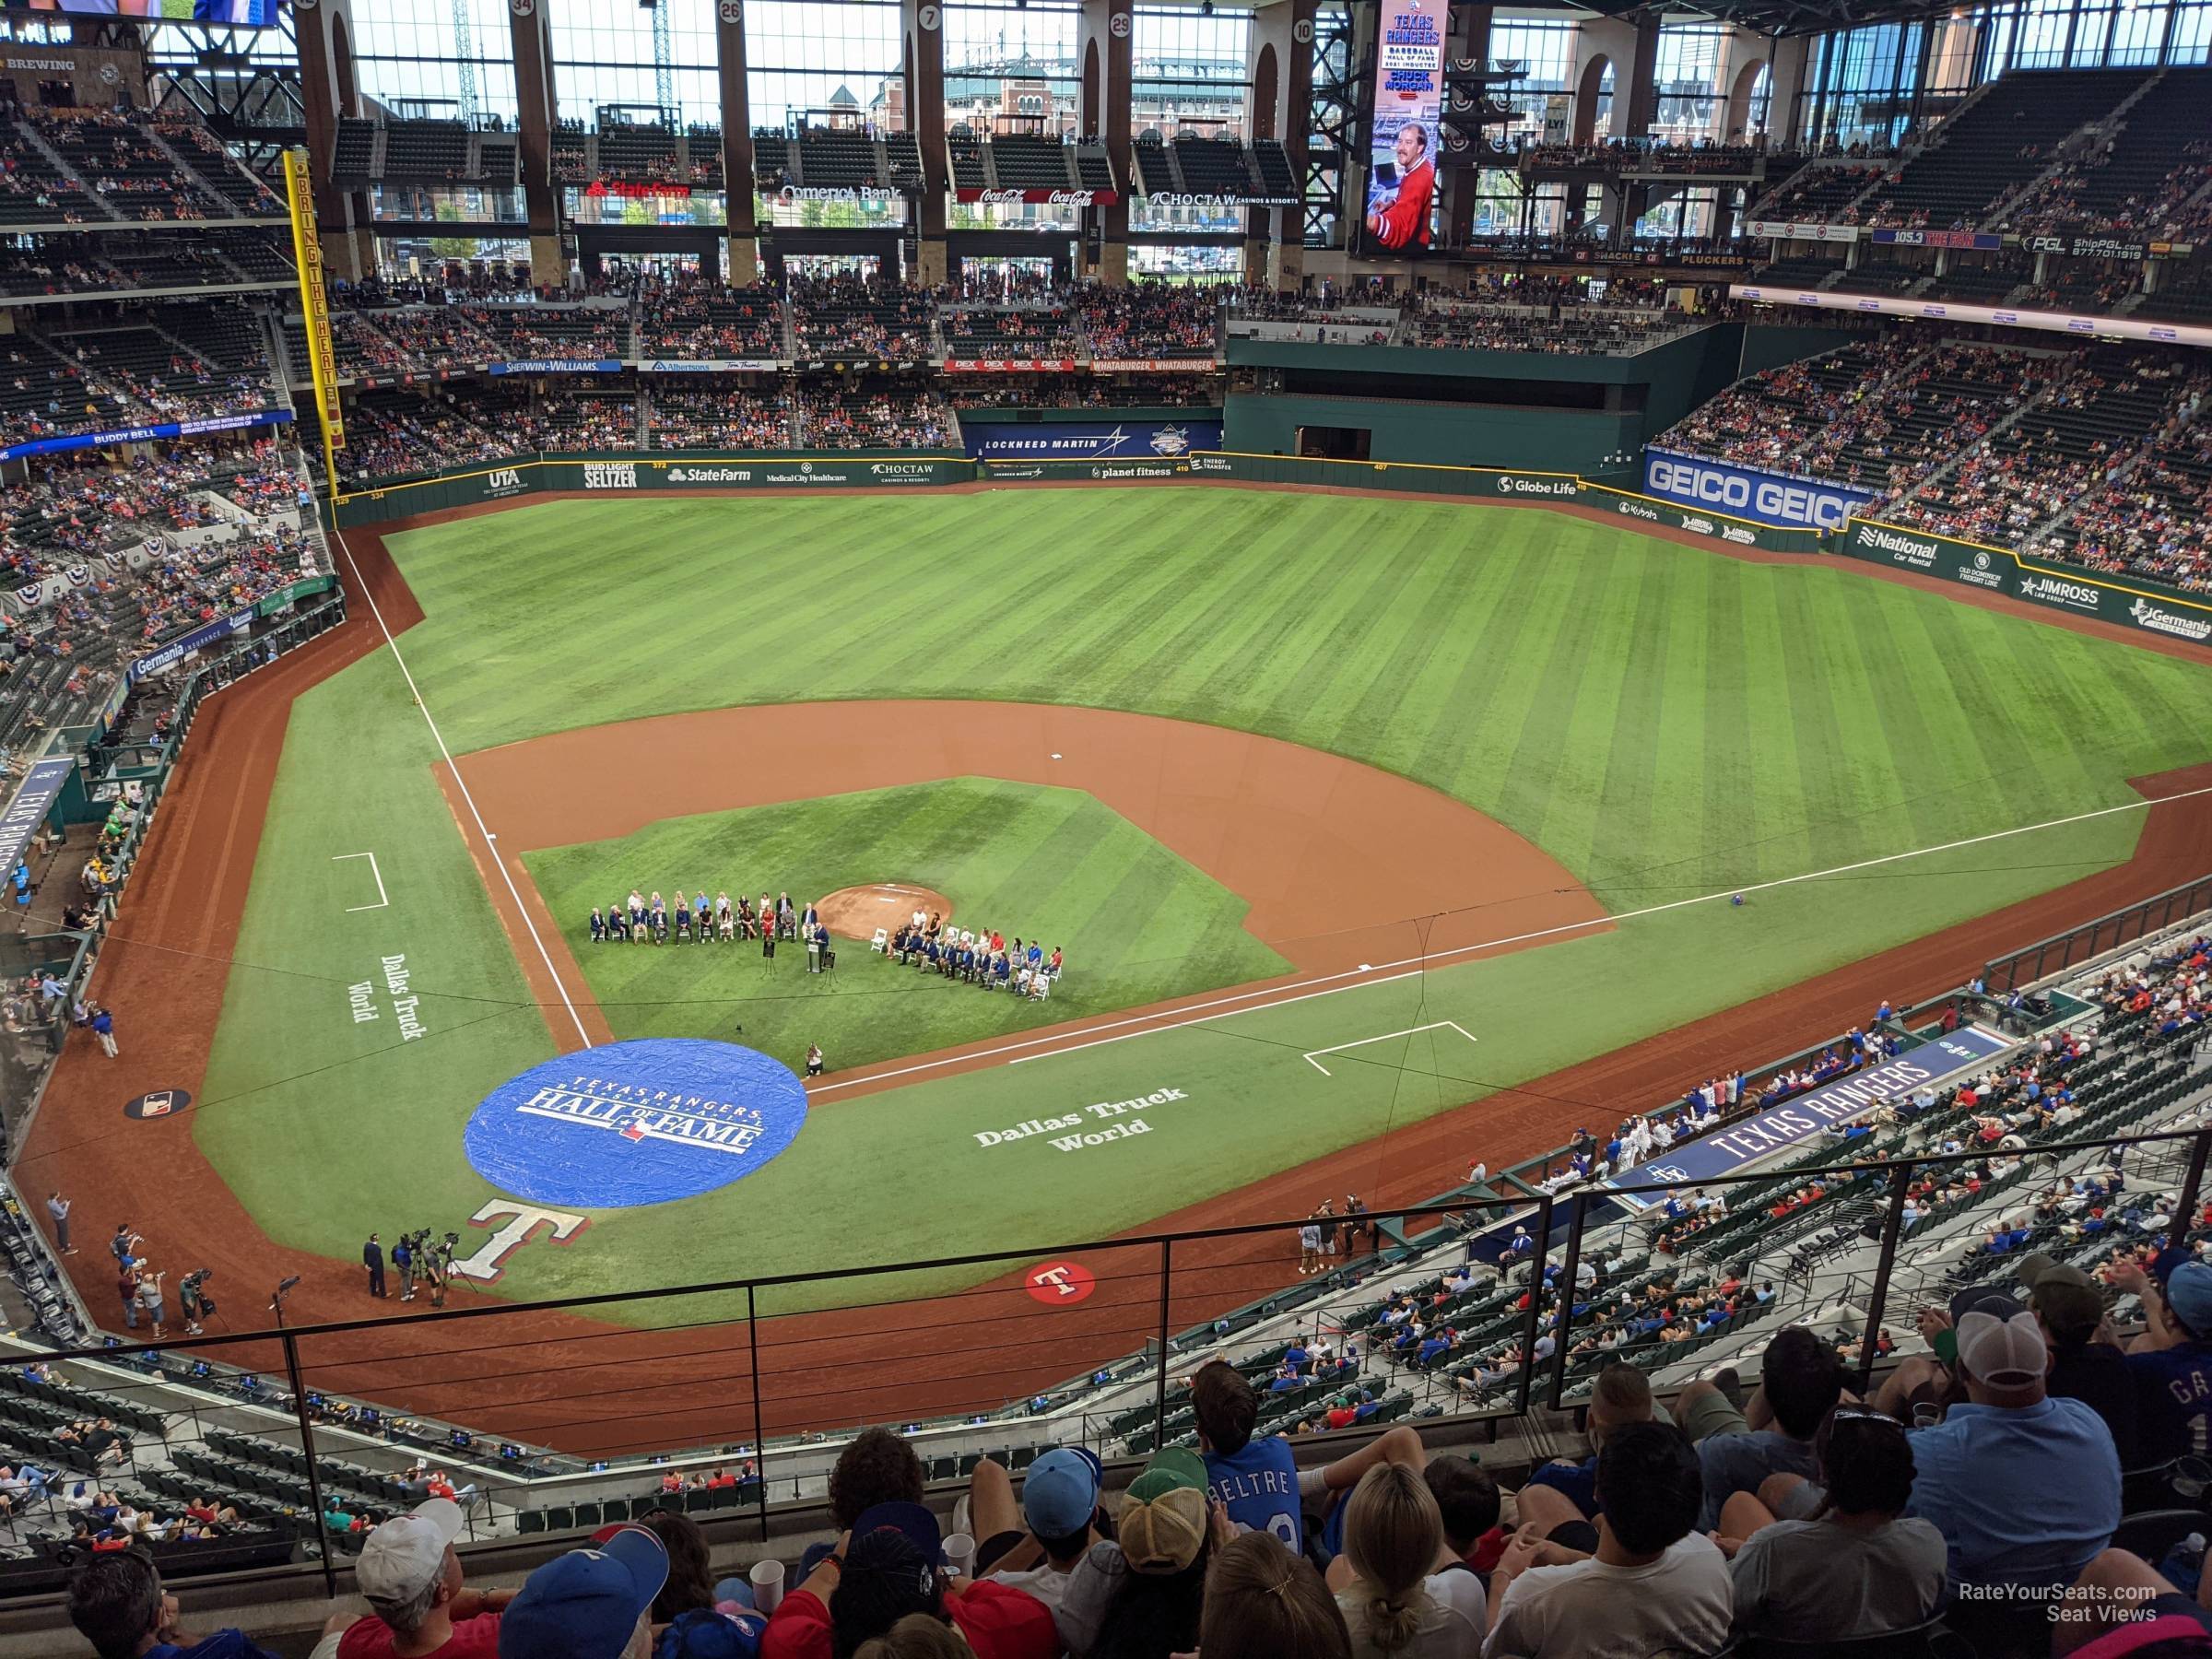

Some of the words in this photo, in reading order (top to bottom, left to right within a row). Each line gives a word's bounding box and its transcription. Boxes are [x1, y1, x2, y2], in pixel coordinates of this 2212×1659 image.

[722, 3, 739, 18] 26
[925, 11, 935, 25] 7
[1112, 18, 1129, 32] 29
[1394, 14, 1434, 29] TEXAS
[1297, 25, 1310, 39] 10
[1385, 29, 1440, 45] RANGERS
[1389, 47, 1435, 55] BASEBALL
[6, 58, 76, 71] BREWING
[1390, 71, 1430, 81] CHUCK
[1385, 81, 1434, 92] MORGAN
[860, 185, 901, 201] Bank
[1159, 192, 1236, 207] CHOCTAW
[1894, 231, 1924, 243] 105.3
[1925, 232, 1947, 245] THE
[1949, 233, 1975, 248] FAN
[2031, 238, 2066, 251] PGL
[2074, 239, 2143, 252] ShipPGL.com
[1681, 255, 1744, 266] PLUCKERS
[2072, 248, 2141, 260] 877.701.1919
[667, 362, 710, 371] Albertsons
[1093, 360, 1150, 371] WHATABURGER
[1155, 360, 1212, 371] WHATABURGER
[414, 373, 431, 382] TOYOTA
[449, 370, 466, 378] TOYOTA
[94, 432, 129, 444] BUDDY
[131, 429, 157, 440] BELL
[985, 440, 1047, 449] LOCKHEED
[1053, 439, 1098, 448] MARTIN
[688, 468, 721, 481] State
[721, 468, 751, 481] Farm
[878, 464, 934, 474] CHOCTAW
[1102, 467, 1135, 478] planet
[1136, 466, 1171, 477] fitness
[489, 469, 520, 488] UTA
[584, 470, 637, 488] SELTZER
[767, 474, 794, 483] Medical
[794, 474, 808, 484] City
[809, 474, 847, 483] Healthcare
[1649, 460, 1749, 508] GEICO
[1515, 480, 1548, 494] Globe
[1551, 483, 1575, 496] Life
[335, 497, 349, 506] 329
[371, 492, 384, 500] 334
[1630, 506, 1658, 521] Kubota
[1691, 518, 1712, 530] ARROW
[1731, 528, 1752, 540] ARROW
[1894, 553, 1907, 561] Car
[1908, 556, 1932, 568] Rental
[1959, 566, 1977, 576] OLD
[1971, 570, 2002, 582] DOMINION
[1959, 573, 1984, 586] FREIGHT
[1984, 578, 1998, 588] LINE
[2034, 591, 2046, 599] LAW
[2046, 594, 2065, 604] GROUP
[2152, 609, 2212, 634] Germania
[2153, 623, 2199, 638] INSURANCE
[184, 629, 221, 653] INSURANCE
[137, 643, 184, 675] Germania
[6, 790, 50, 823] TEXAS
[382, 953, 408, 995] Dallas
[347, 981, 379, 1023] World
[394, 995, 429, 1041] Truck
[571, 1076, 647, 1096] TEXAS
[654, 1090, 762, 1119] RANGERS
[973, 1112, 1083, 1147] Dallas
[1085, 1088, 1189, 1118] Truck
[1709, 1109, 1815, 1159] TEXAS
[1804, 1061, 1931, 1122] RANGERS
[524, 1088, 619, 1122] HALL
[630, 1109, 652, 1119] OF
[652, 1114, 764, 1148] FAME
[1047, 1119, 1153, 1152] World
[1207, 1470, 1289, 1506] BELTRE
